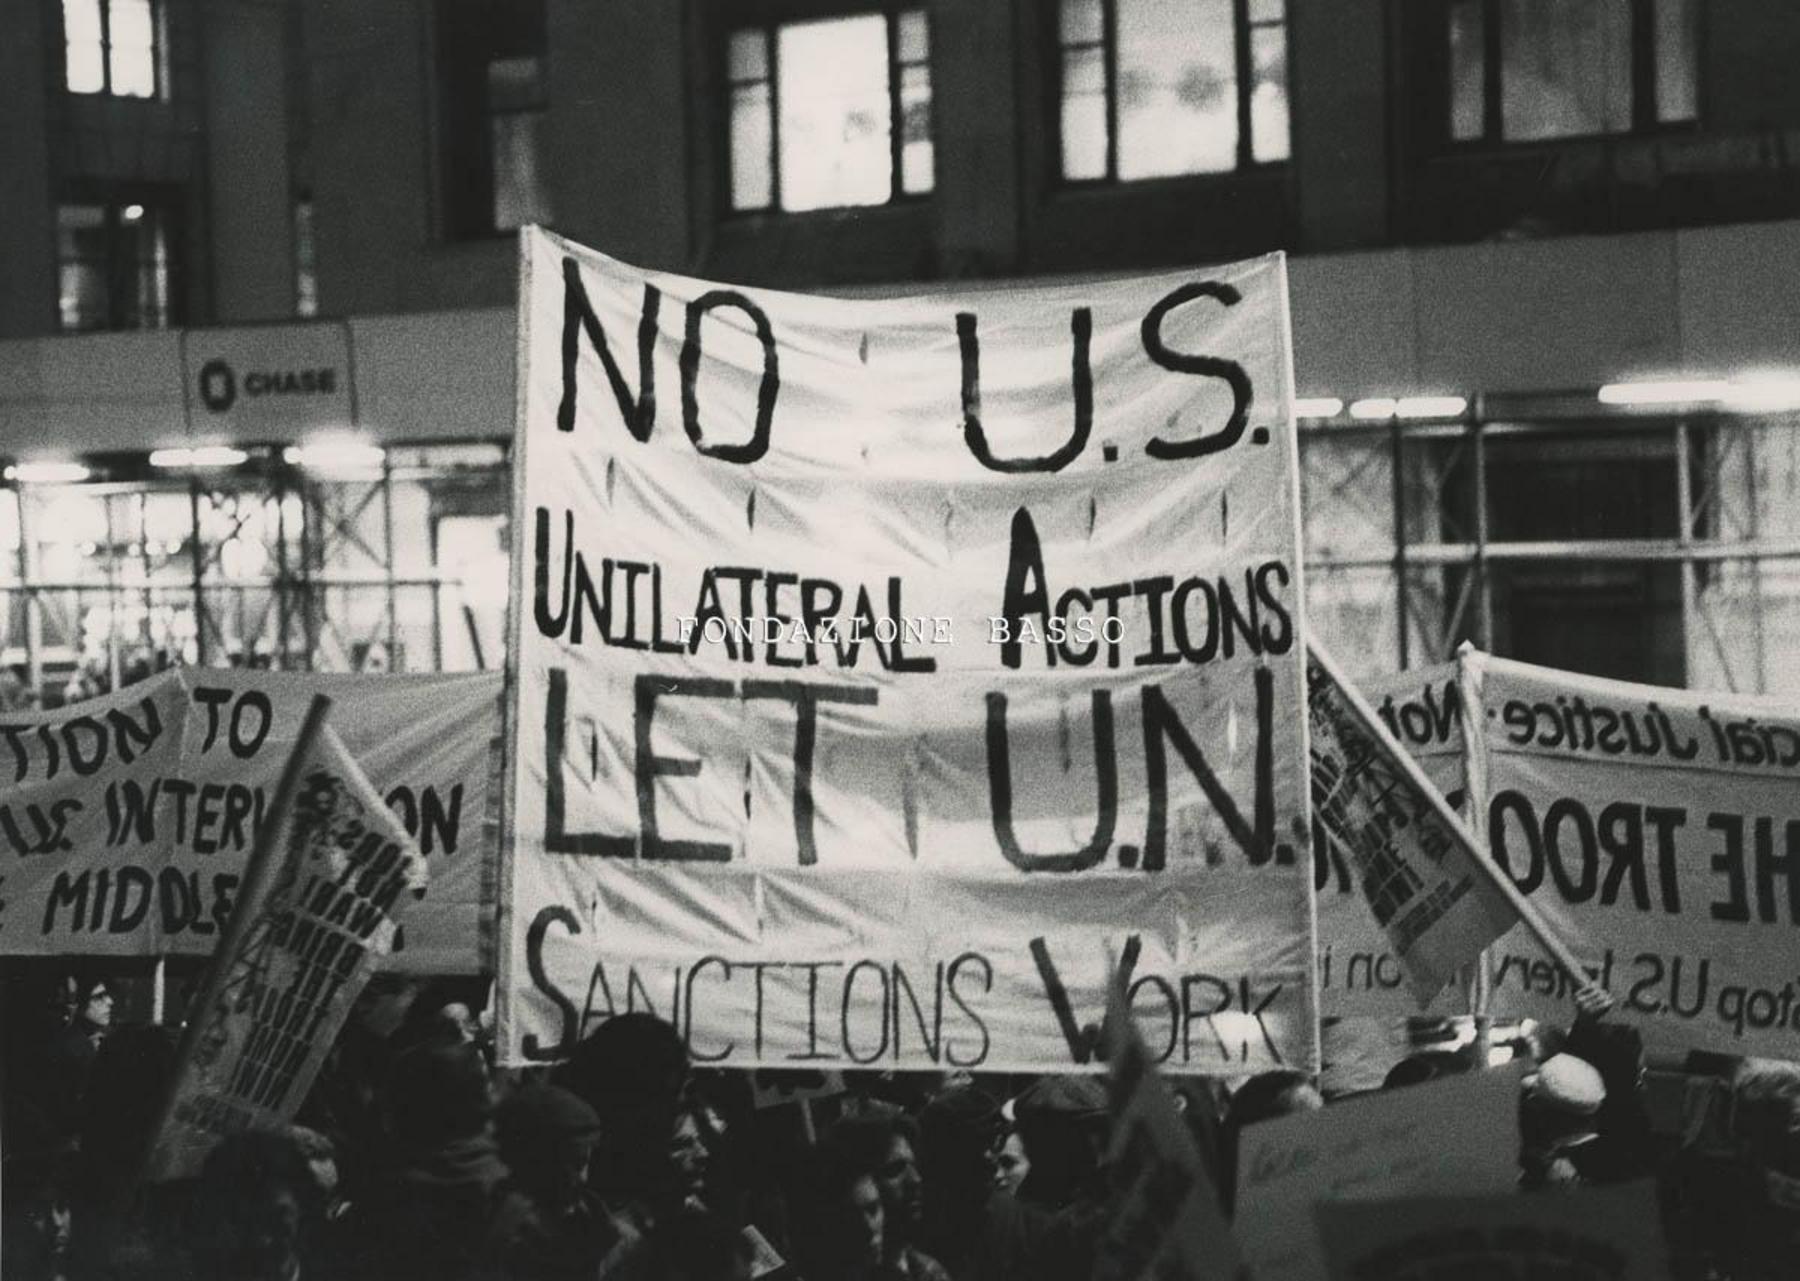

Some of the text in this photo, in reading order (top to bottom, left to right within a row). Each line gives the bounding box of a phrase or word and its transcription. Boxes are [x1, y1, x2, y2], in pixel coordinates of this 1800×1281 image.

[245, 368, 336, 397] CHASE
[557, 256, 1269, 473] NO U.S.
[534, 506, 1292, 673] UNILATERAL ACTIONS
[194, 687, 272, 760] TO
[545, 668, 879, 865] LET
[985, 668, 1294, 872] U.N.
[42, 865, 240, 937] MIDDLE
[522, 905, 1282, 1067] SANCTIONS WORK
